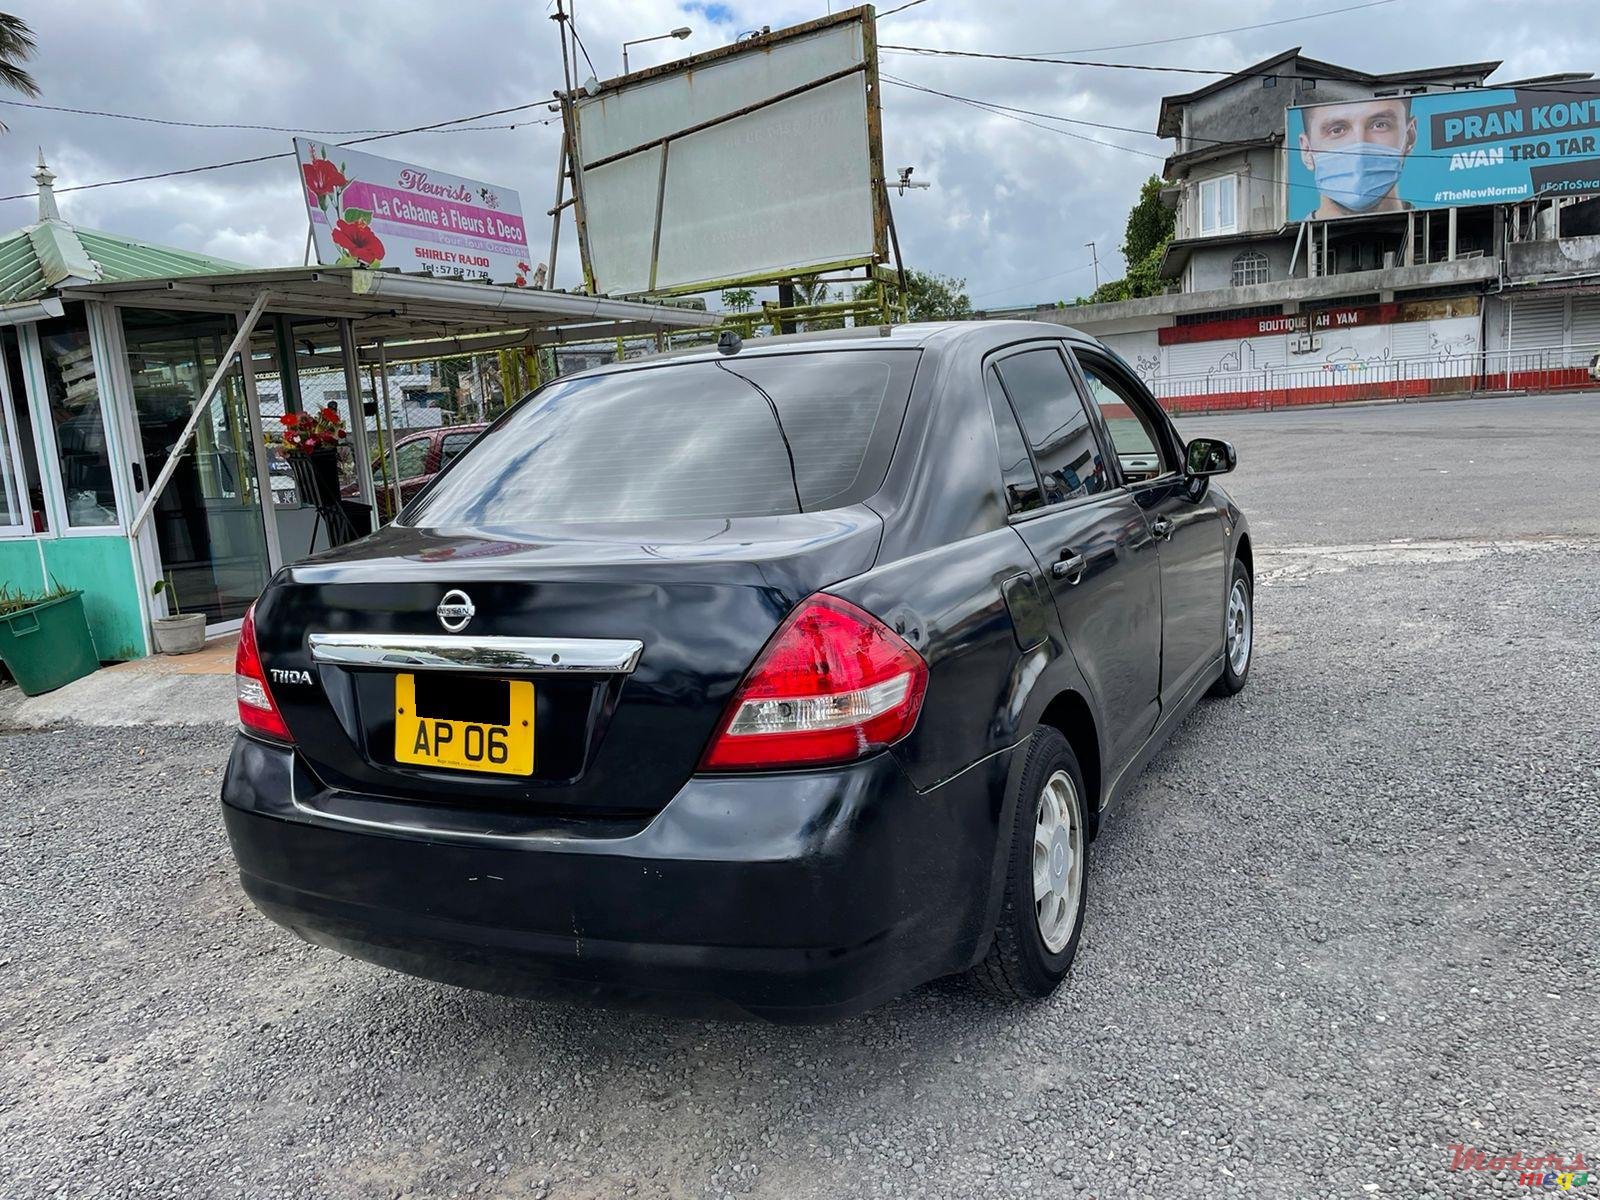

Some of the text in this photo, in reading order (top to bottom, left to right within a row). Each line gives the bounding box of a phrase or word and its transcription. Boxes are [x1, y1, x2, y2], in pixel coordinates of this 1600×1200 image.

[1444, 109, 1523, 142] PRAN
[1449, 135, 1596, 172] AVAN TRO TAR
[398, 168, 472, 203] Fleuriste
[1434, 184, 1528, 202] #TheNewNormal
[373, 193, 522, 242] La Cabane à Fleurs & Deco
[414, 247, 490, 267] SHIRLEY RAJOO
[440, 264, 451, 274] 57
[1259, 312, 1358, 332] BOUTIQUE AH YAM
[270, 668, 313, 685] TIIDA
[413, 719, 510, 763] AP 06
